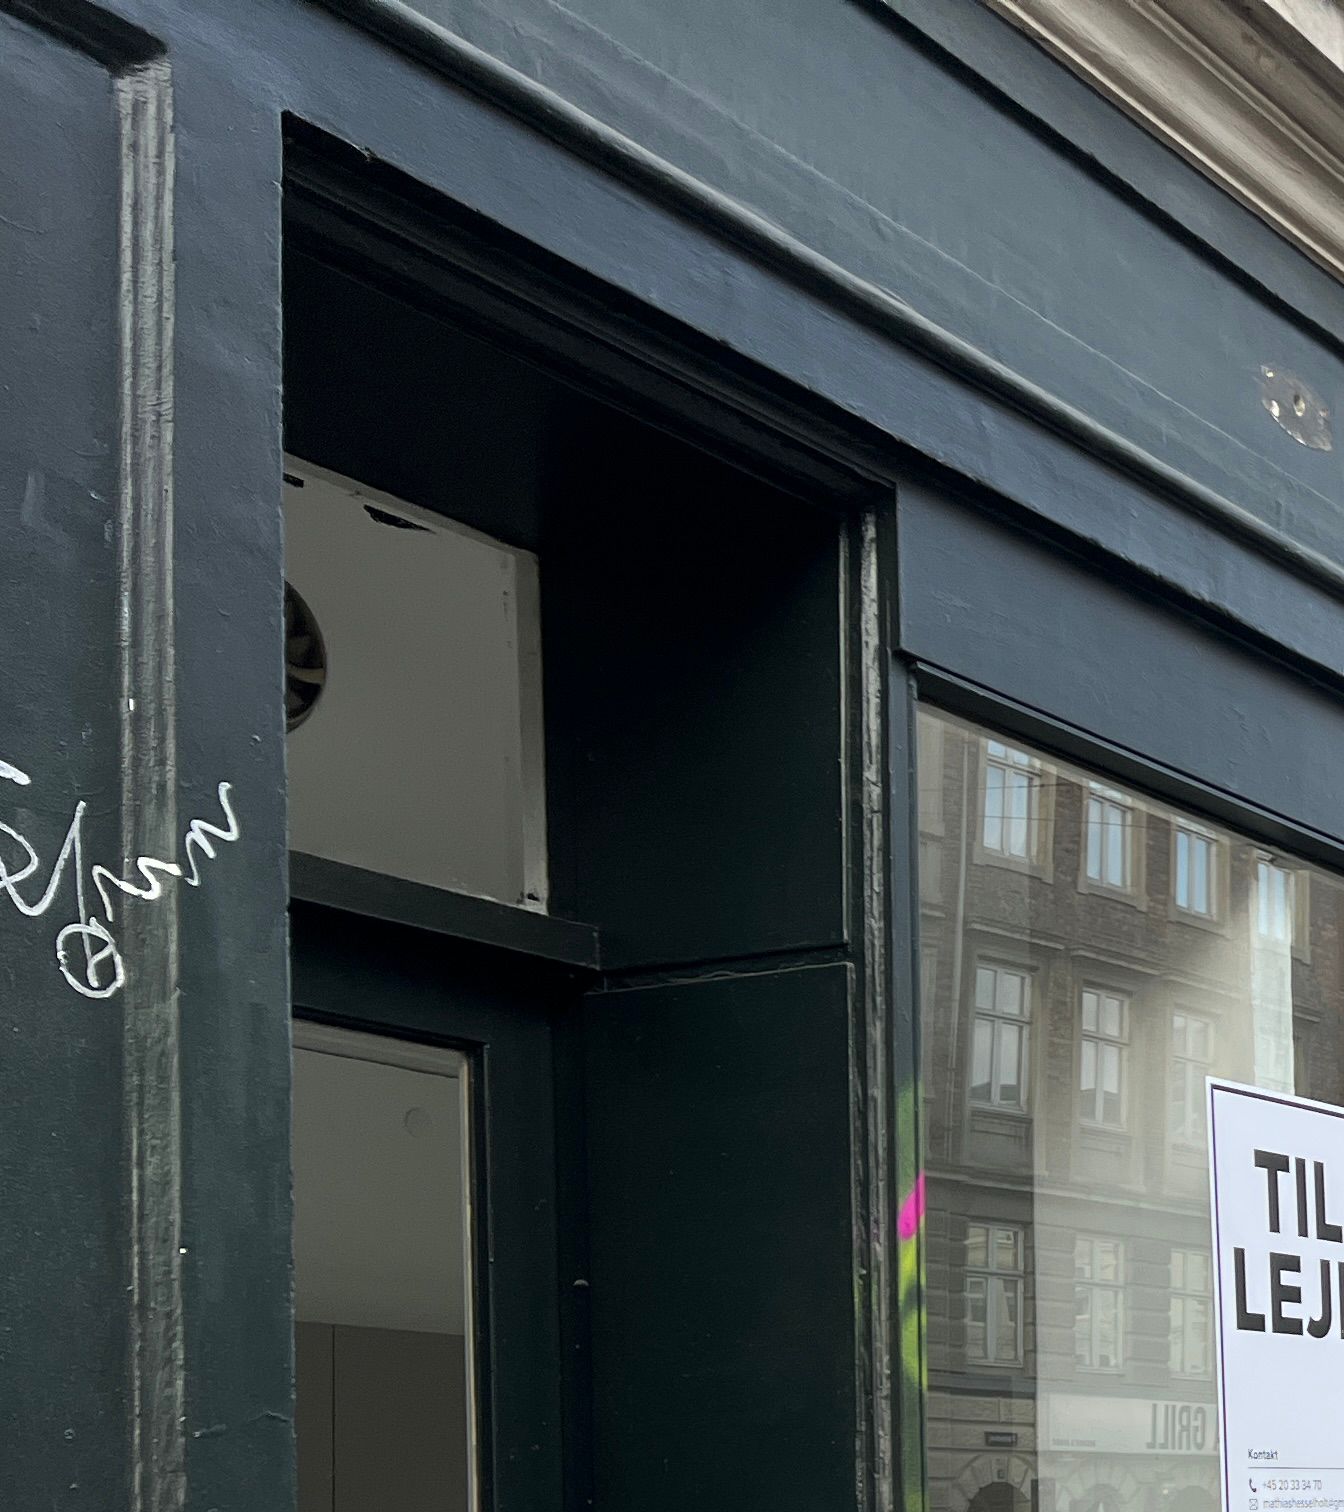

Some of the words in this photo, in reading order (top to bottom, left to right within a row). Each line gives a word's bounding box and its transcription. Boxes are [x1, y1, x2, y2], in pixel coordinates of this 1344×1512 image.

[1253, 1148, 1343, 1243] TIL
[1247, 1448, 1279, 1460] Kontakt
[1262, 1479, 1277, 1491] +45
[1278, 1479, 1289, 1490] 20
[1290, 1479, 1300, 1490] 33
[1301, 1479, 1311, 1490] 34
[1313, 1479, 1323, 1490] 70
